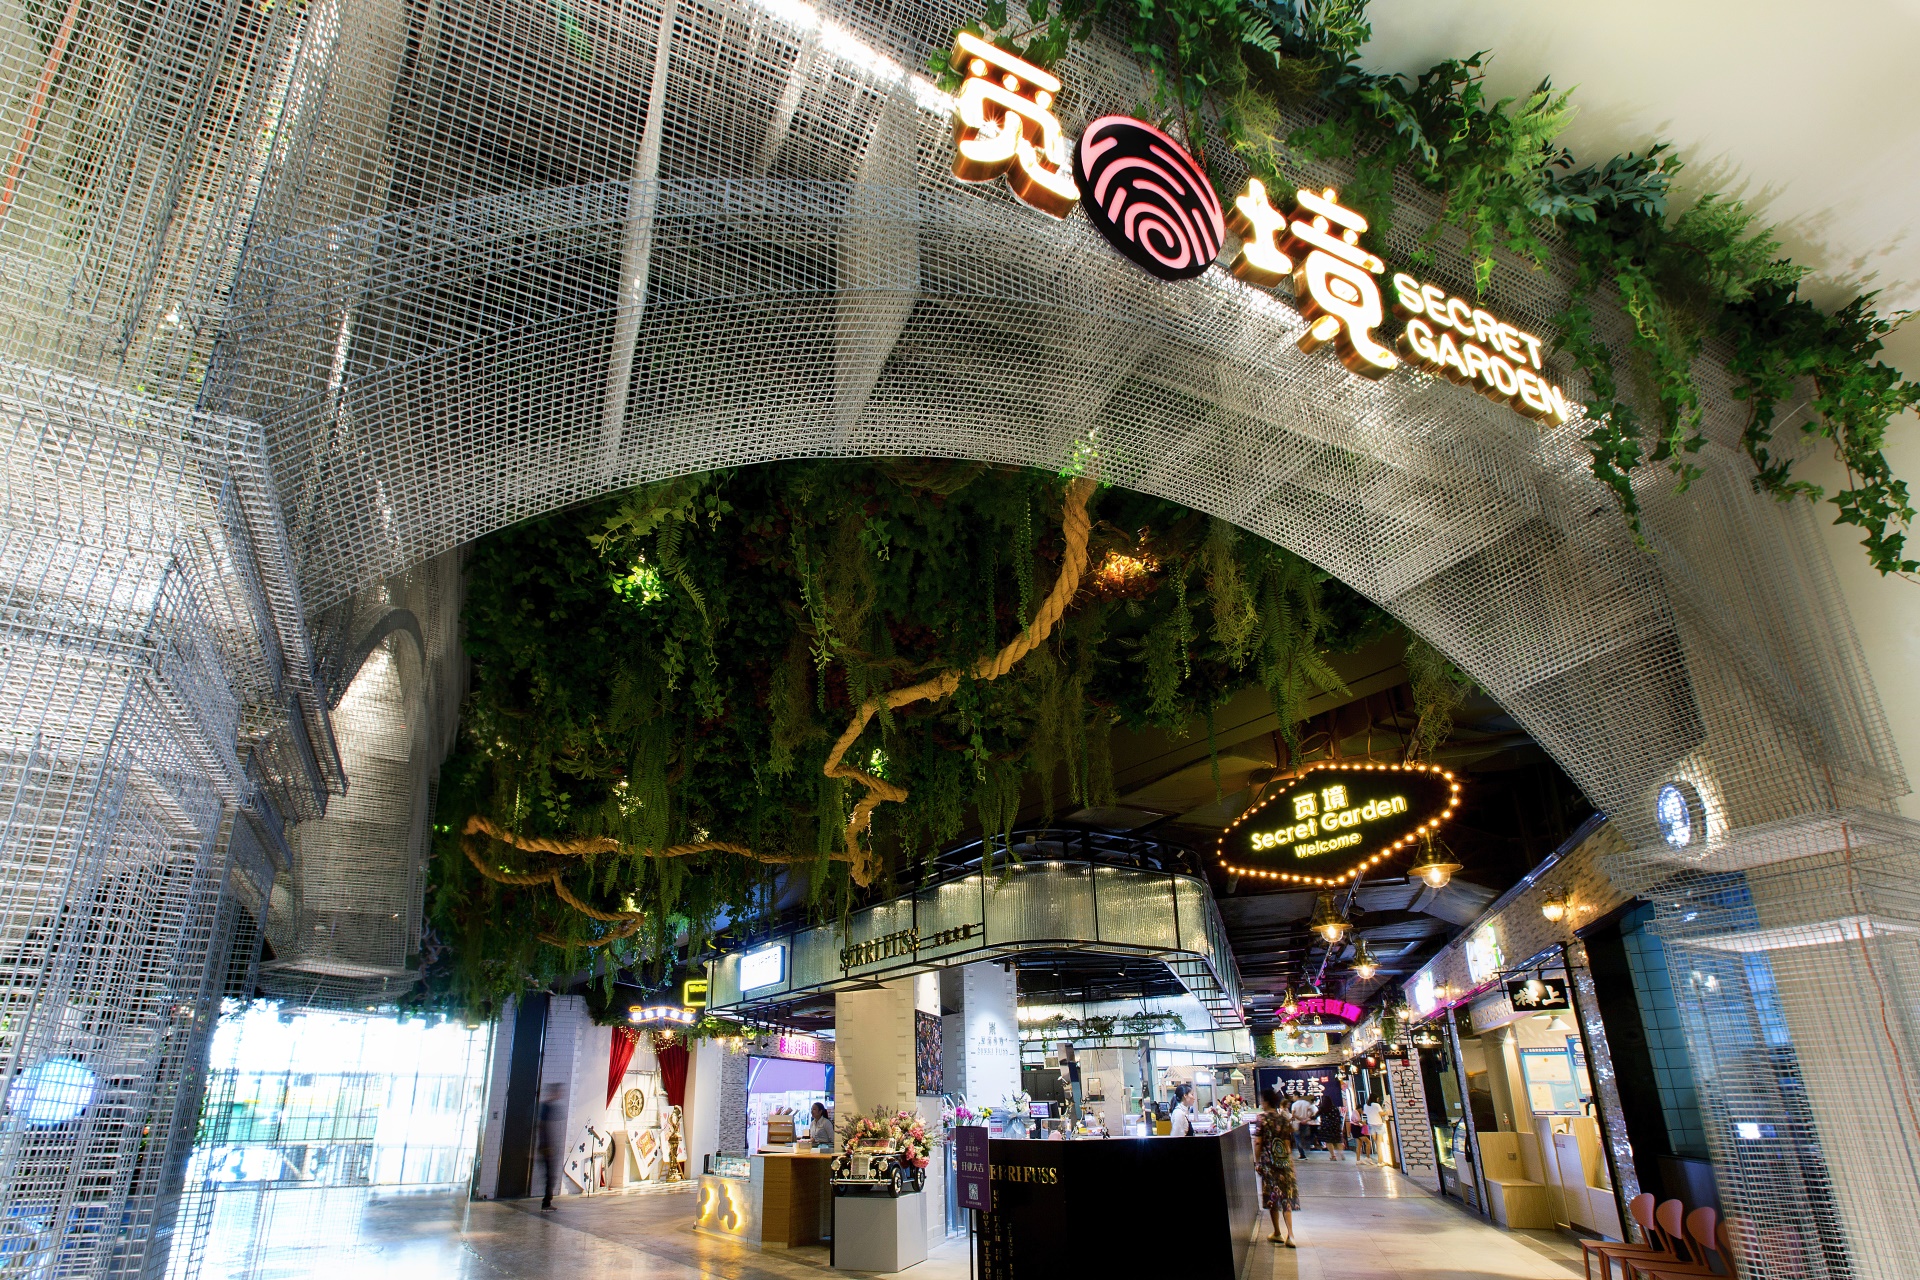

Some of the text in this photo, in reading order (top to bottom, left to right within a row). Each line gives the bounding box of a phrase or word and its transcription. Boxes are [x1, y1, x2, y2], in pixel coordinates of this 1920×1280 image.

[1393, 273, 1543, 369] SECRET
[1399, 319, 1568, 427] GARDEN
[1251, 795, 1407, 851] Secret Garden
[1294, 832, 1362, 858] Welcome
